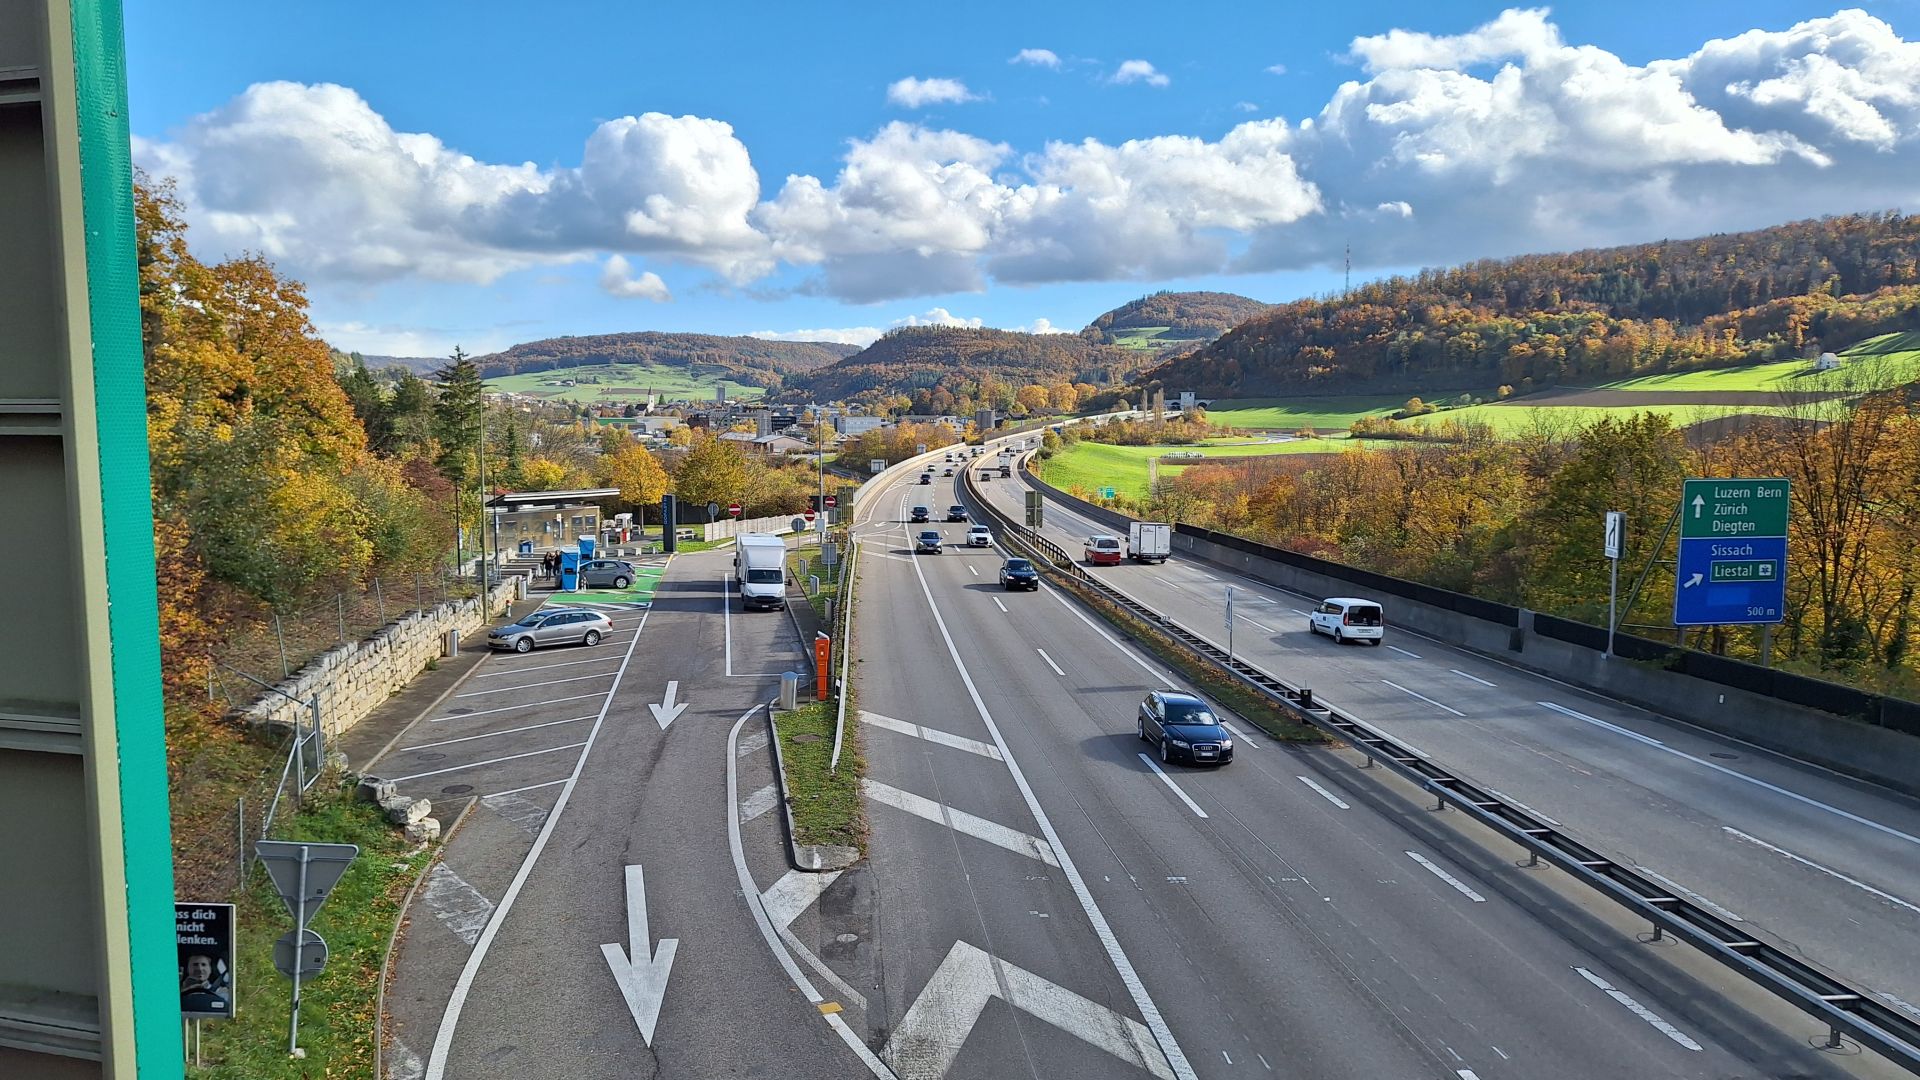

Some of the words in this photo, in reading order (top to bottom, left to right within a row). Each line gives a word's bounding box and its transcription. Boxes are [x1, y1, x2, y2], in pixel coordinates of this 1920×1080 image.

[1714, 486, 1750, 498] Luzern
[1757, 486, 1782, 498] Bern
[1713, 503, 1748, 515] Zürich
[1712, 520, 1755, 534] Diegten
[1711, 544, 1753, 556] Sissach
[1714, 565, 1753, 577] Liestal
[1747, 606, 1764, 616] 500
[1767, 608, 1775, 616] m
[192, 909, 216, 920] dich
[176, 921, 204, 932] nicht
